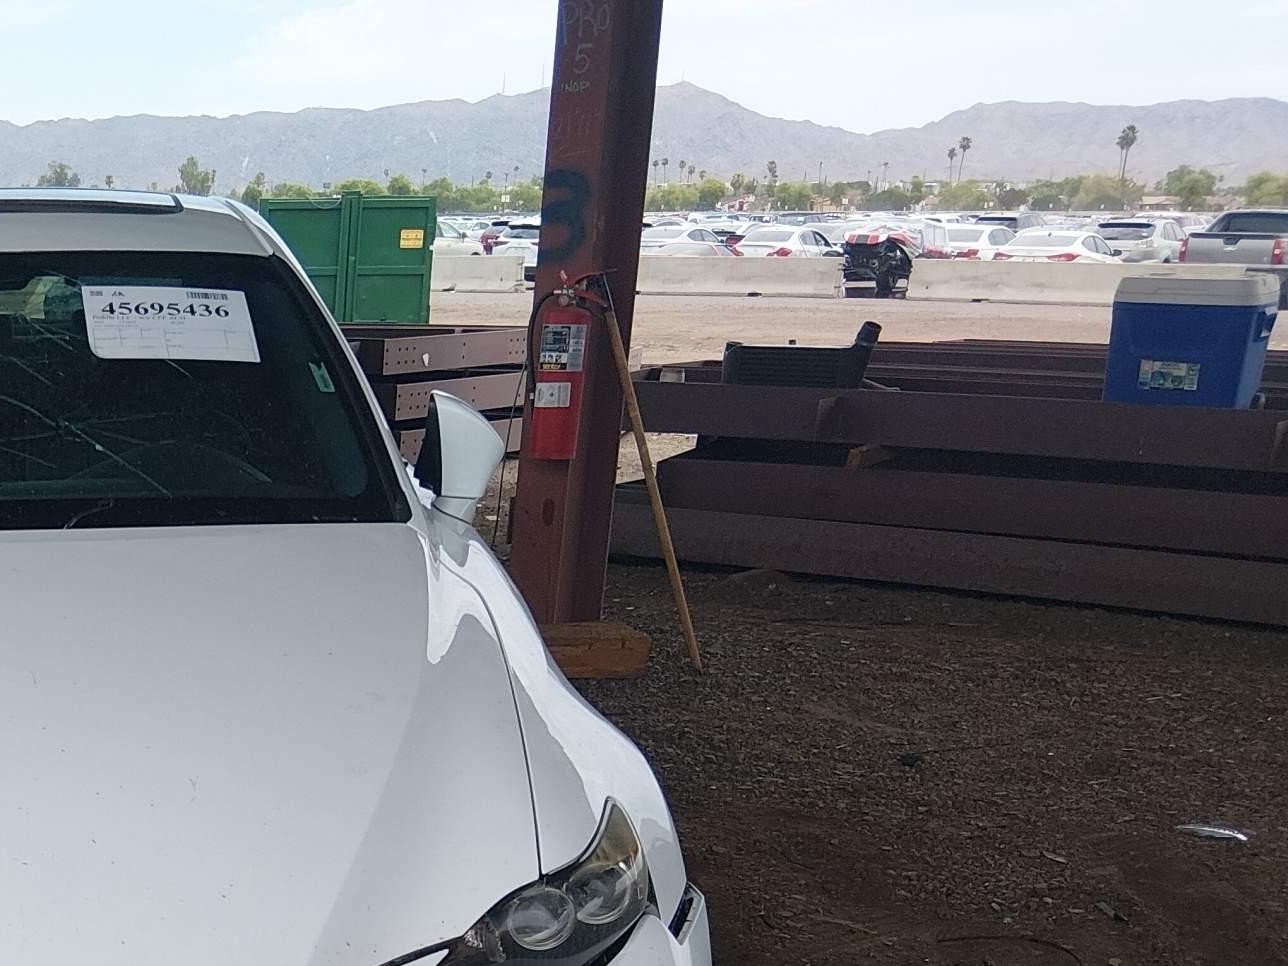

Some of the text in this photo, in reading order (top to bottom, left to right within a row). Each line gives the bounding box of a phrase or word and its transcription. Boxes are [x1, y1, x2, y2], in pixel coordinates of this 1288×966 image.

[572, 42, 593, 74] 5
[560, 80, 591, 94] INOP
[538, 168, 591, 267] 3
[101, 301, 230, 318] 45695436
